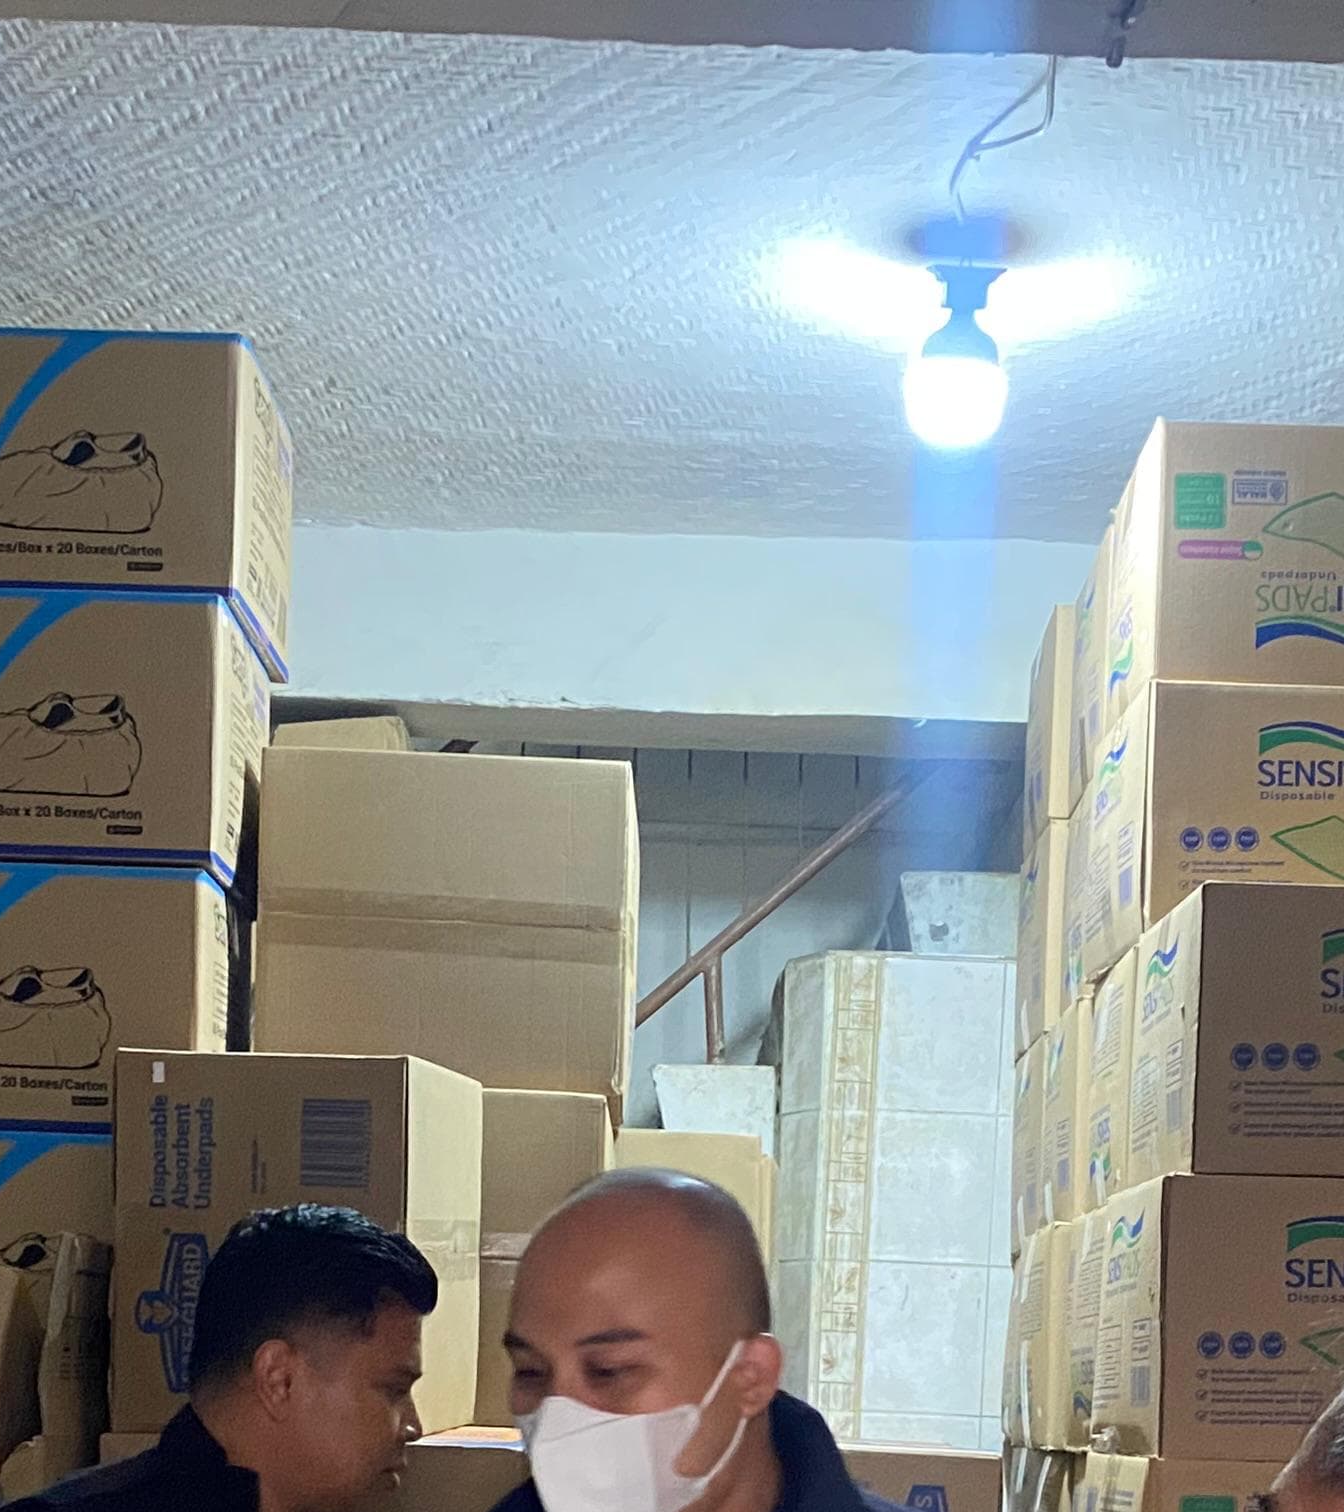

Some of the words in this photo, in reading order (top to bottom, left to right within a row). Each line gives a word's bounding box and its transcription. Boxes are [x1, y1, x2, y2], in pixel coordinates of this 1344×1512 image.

[58, 542, 74, 556] 20
[77, 543, 163, 558] Boxes/Carton
[1260, 570, 1337, 583] Underpads
[1256, 584, 1330, 613] PADS
[1257, 760, 1344, 788] SENSI
[1260, 790, 1335, 801] Disposable
[35, 806, 52, 819] 20
[56, 807, 143, 822] Boxes/Carton
[1, 1074, 17, 1088] 20
[149, 1094, 169, 1208] Disposable
[172, 1102, 192, 1210] Absorbent
[193, 1097, 216, 1210] Underpads
